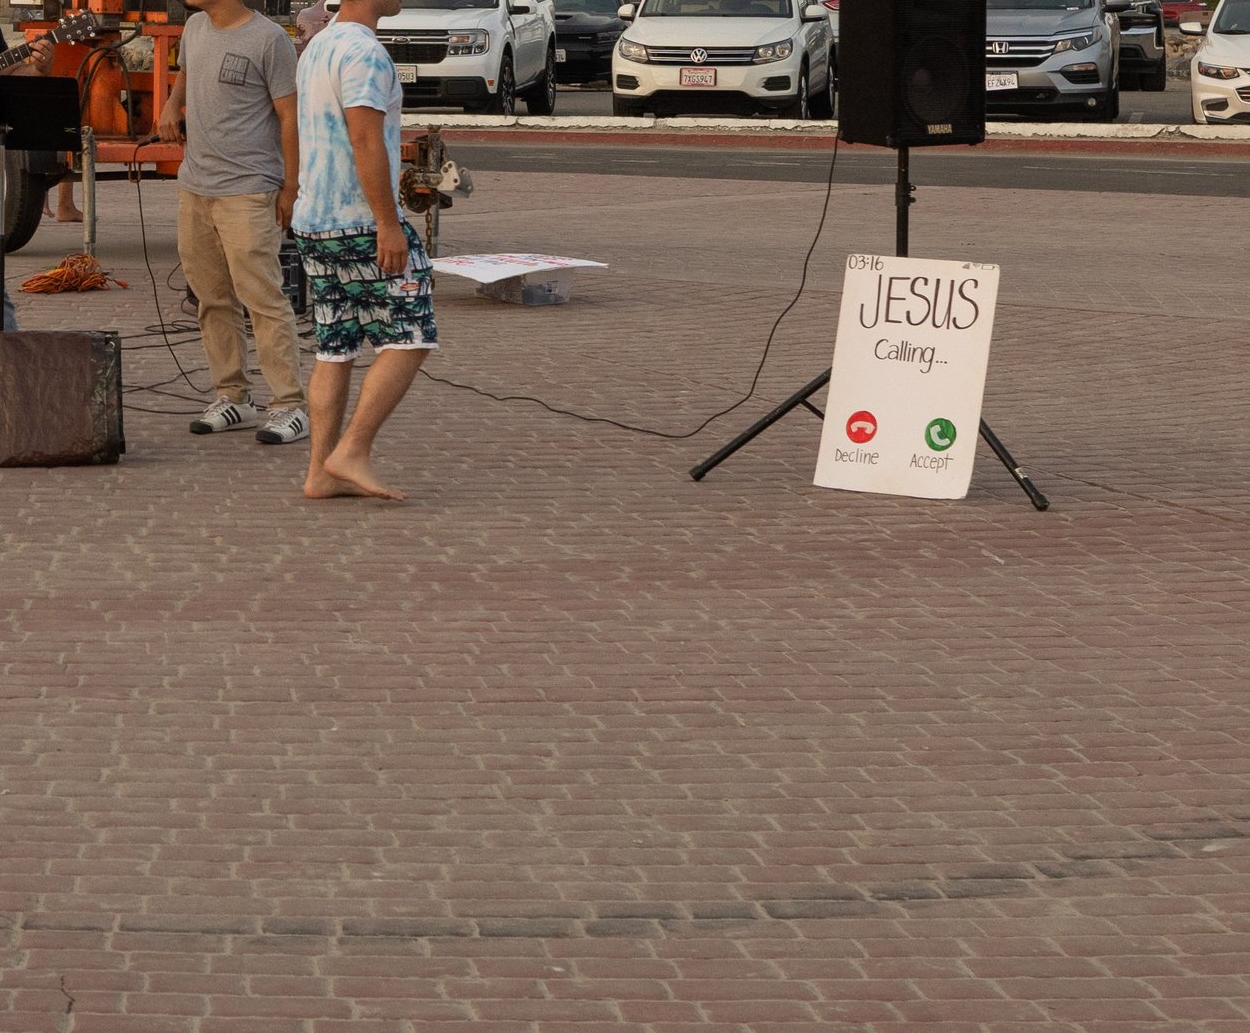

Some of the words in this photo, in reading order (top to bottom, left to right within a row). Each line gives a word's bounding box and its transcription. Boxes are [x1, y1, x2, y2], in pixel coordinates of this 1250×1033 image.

[927, 123, 953, 135] YAMAHA
[848, 254, 884, 271] 03:16
[860, 274, 979, 330] JESUS
[835, 448, 879, 465] Decline
[910, 454, 954, 473] Accept
